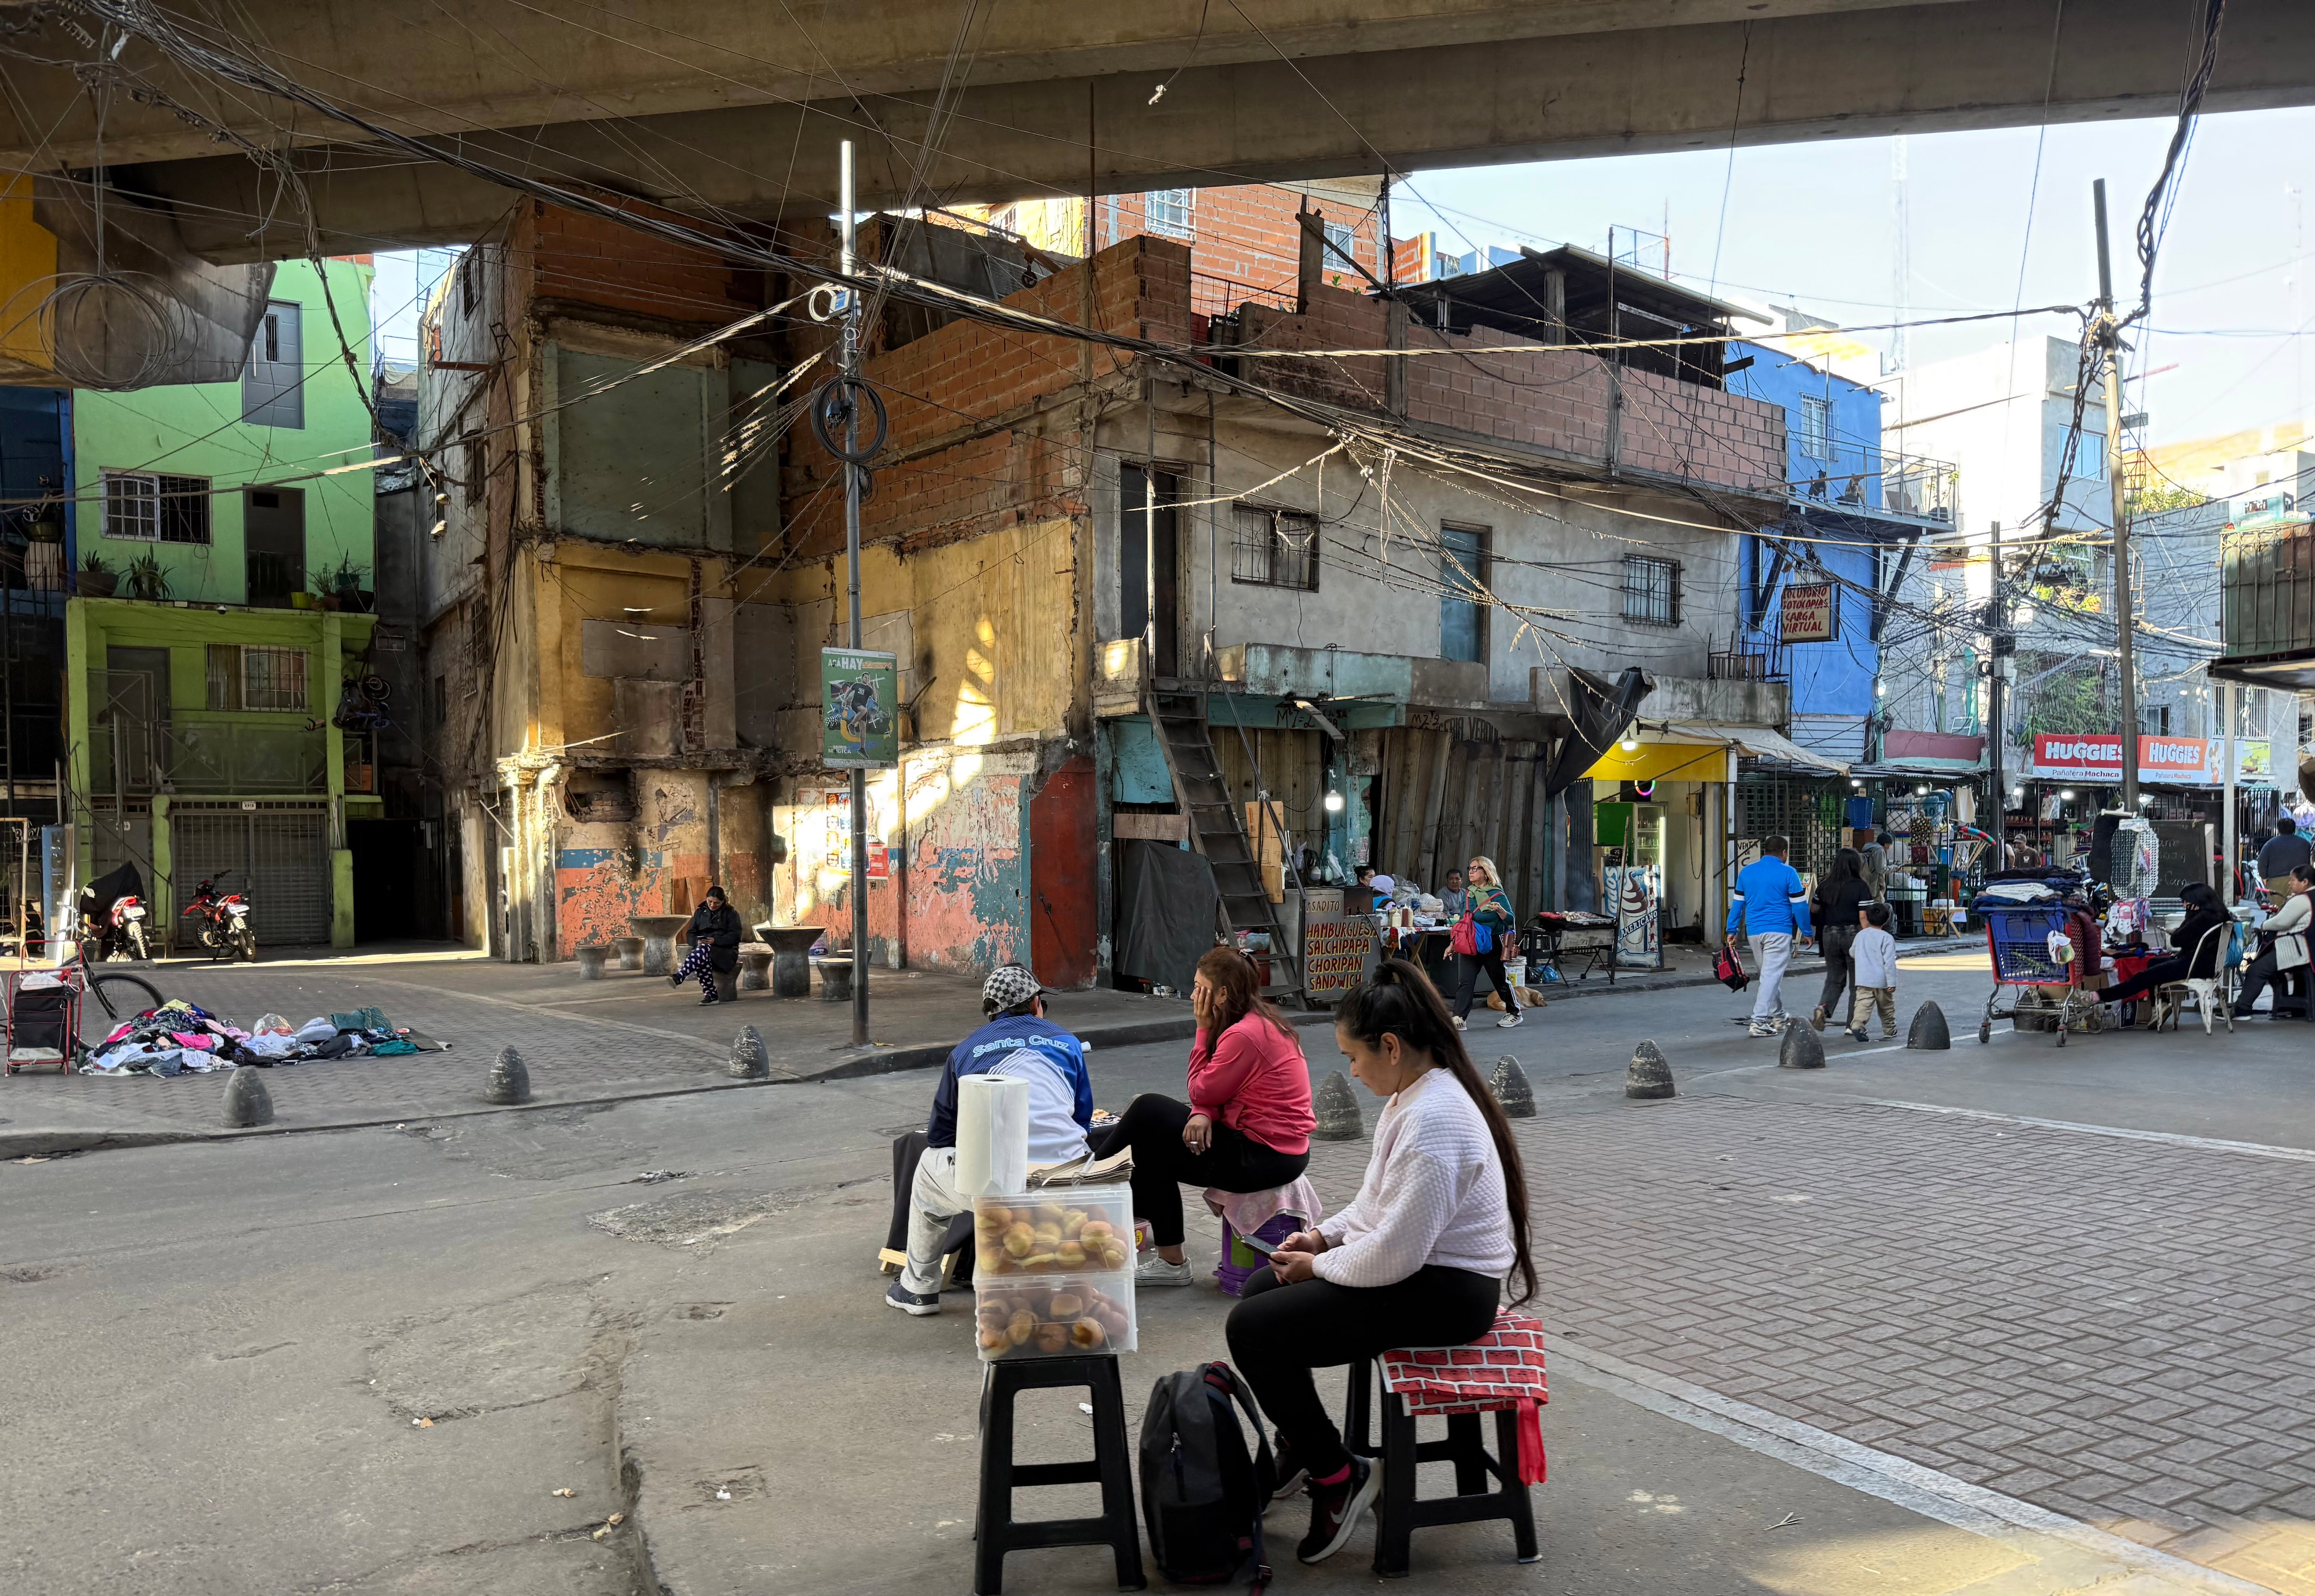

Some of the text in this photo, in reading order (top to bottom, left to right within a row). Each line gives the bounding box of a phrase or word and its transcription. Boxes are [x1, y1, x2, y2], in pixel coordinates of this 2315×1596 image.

[1783, 598, 1828, 610] FOTOCOPIAS
[1785, 611, 1815, 623] CARGA
[1783, 621, 1822, 633] VIRTUAL
[841, 657, 863, 670] HAY
[2149, 742, 2200, 764] HUGGIES
[1738, 841, 1758, 850] VENTA
[1605, 867, 1618, 914] ados
[1307, 901, 1340, 912] ASADITO
[1620, 909, 1658, 940] AMERICANO
[1307, 938, 1370, 958] SALCHIPAPA
[1308, 956, 1364, 974] CHORIPAN
[1310, 973, 1363, 991] SANDWICH
[972, 1035, 1069, 1058] Santa Cruz
